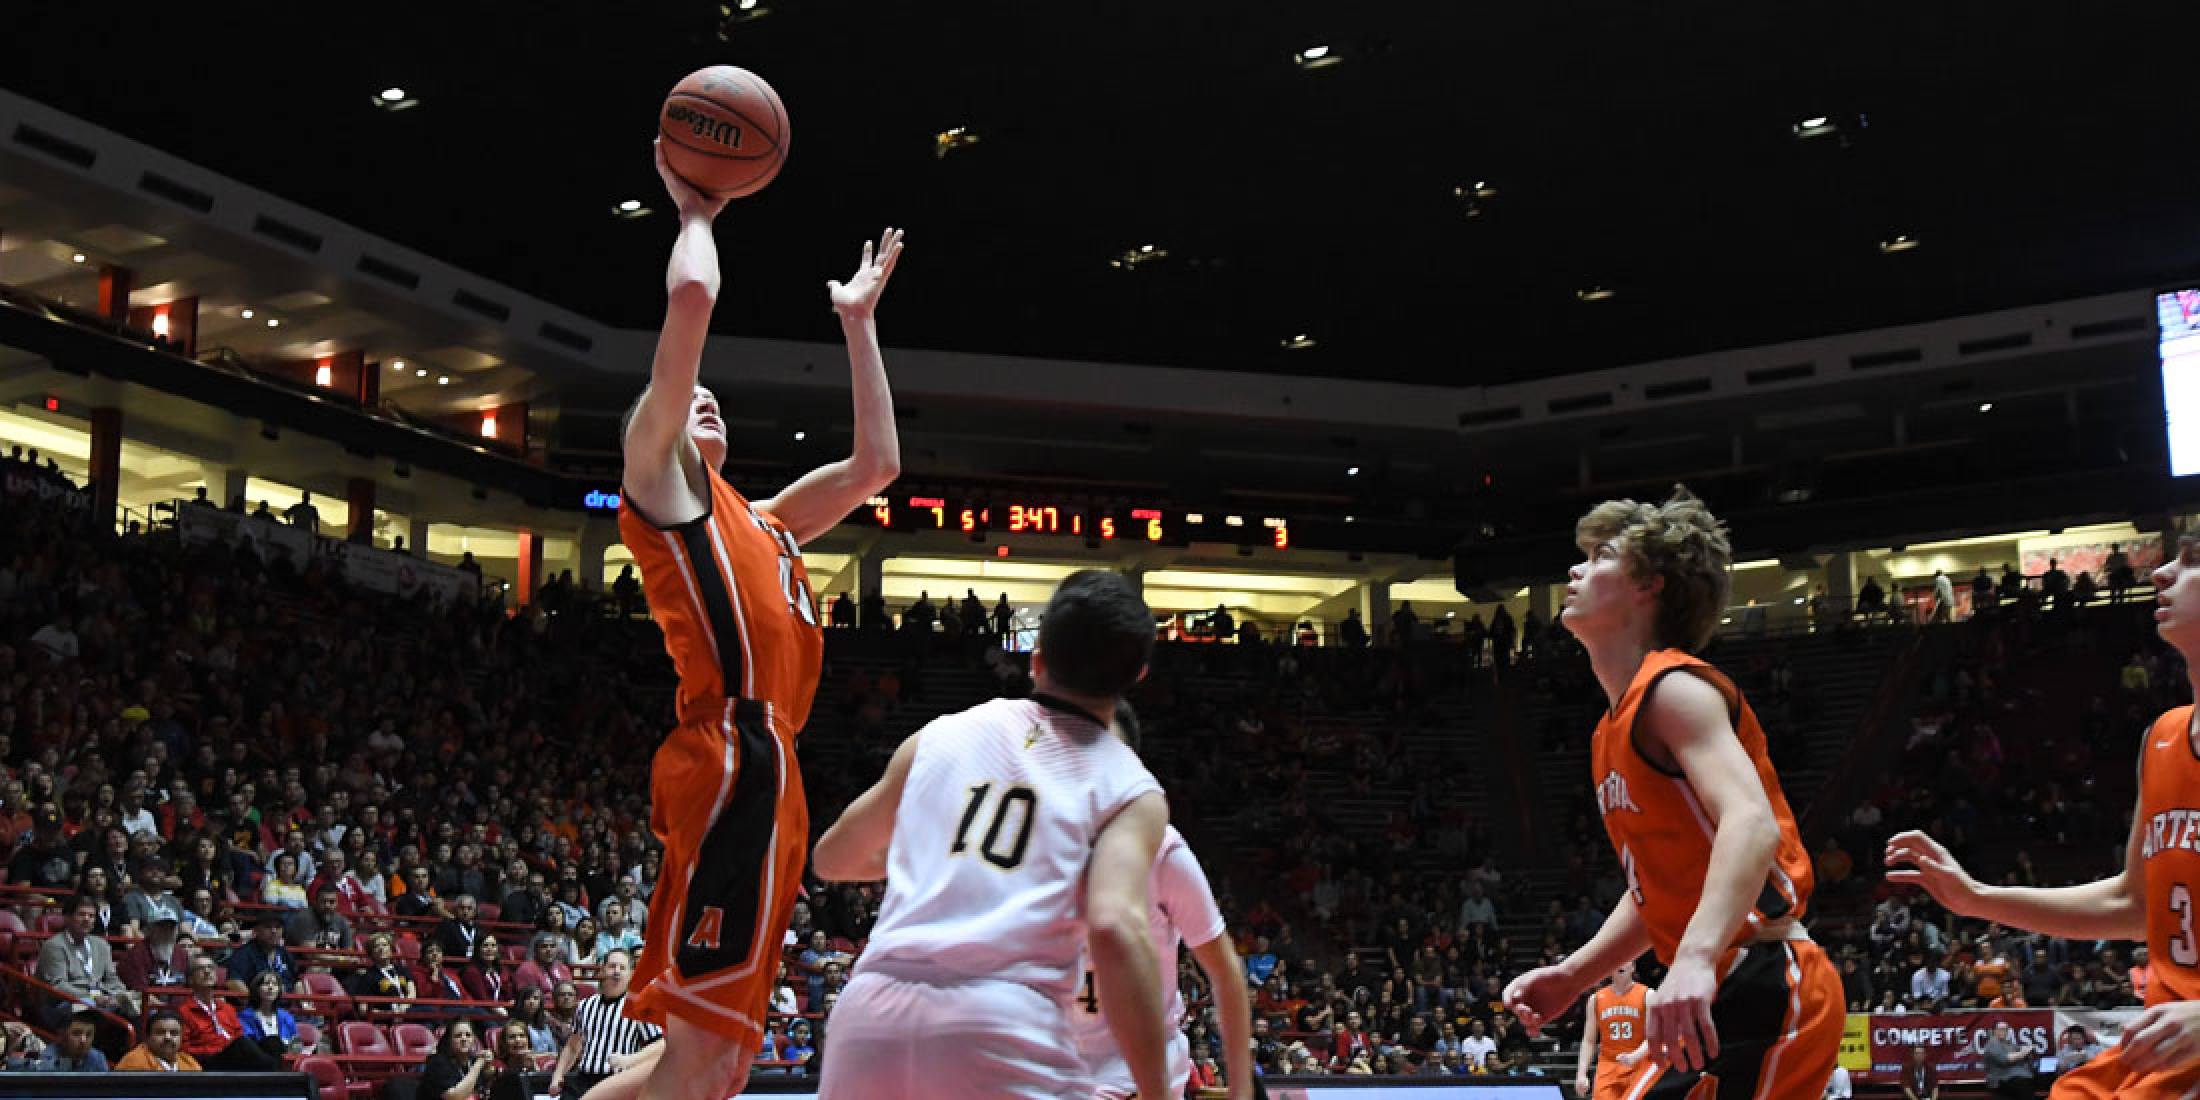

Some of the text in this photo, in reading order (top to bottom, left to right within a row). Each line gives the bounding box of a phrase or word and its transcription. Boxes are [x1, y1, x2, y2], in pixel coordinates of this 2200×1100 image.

[667, 104, 743, 150] Wilson
[874, 507, 890, 527] 4
[932, 507, 943, 528] 7
[961, 509, 974, 531] 5
[1009, 505, 1057, 532] 3:47
[1101, 517, 1115, 538] 5
[1147, 518, 1162, 541] 6
[1274, 526, 1289, 549] 3
[950, 780, 1038, 872] 10
[687, 905, 724, 950] A
[1608, 1021, 1634, 1040] 33
[1873, 1026, 1969, 1046] COMPETE
